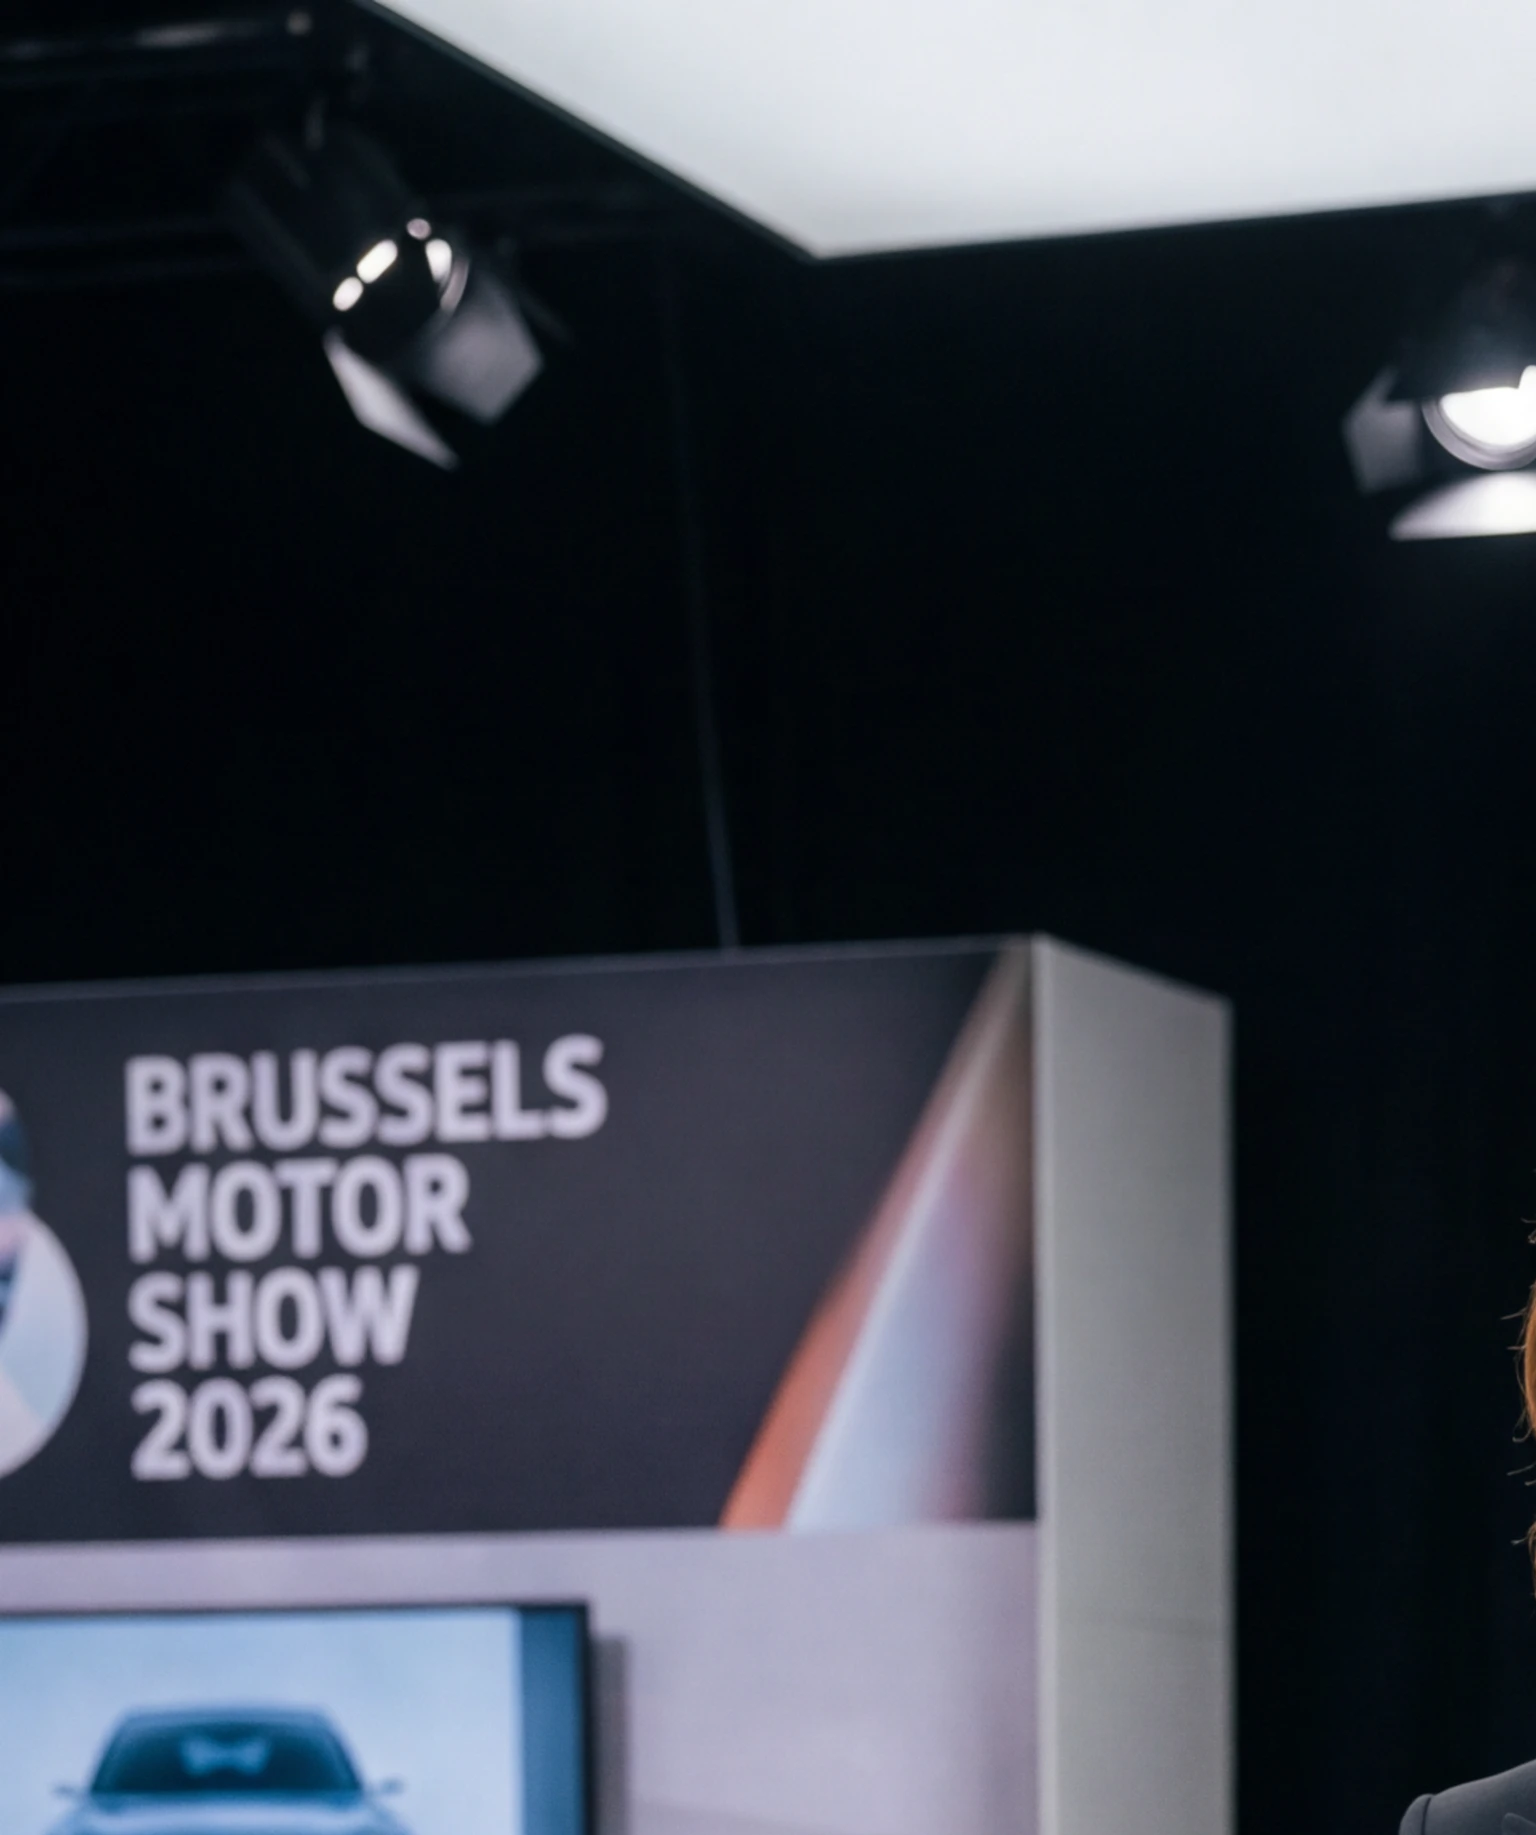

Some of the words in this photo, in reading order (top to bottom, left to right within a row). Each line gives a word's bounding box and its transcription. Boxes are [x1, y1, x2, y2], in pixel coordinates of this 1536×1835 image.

[126, 1035, 607, 1154] BRUSSELS
[128, 1155, 470, 1261] MOTOR
[129, 1266, 418, 1371] SHOW
[132, 1375, 367, 1479] 2026
